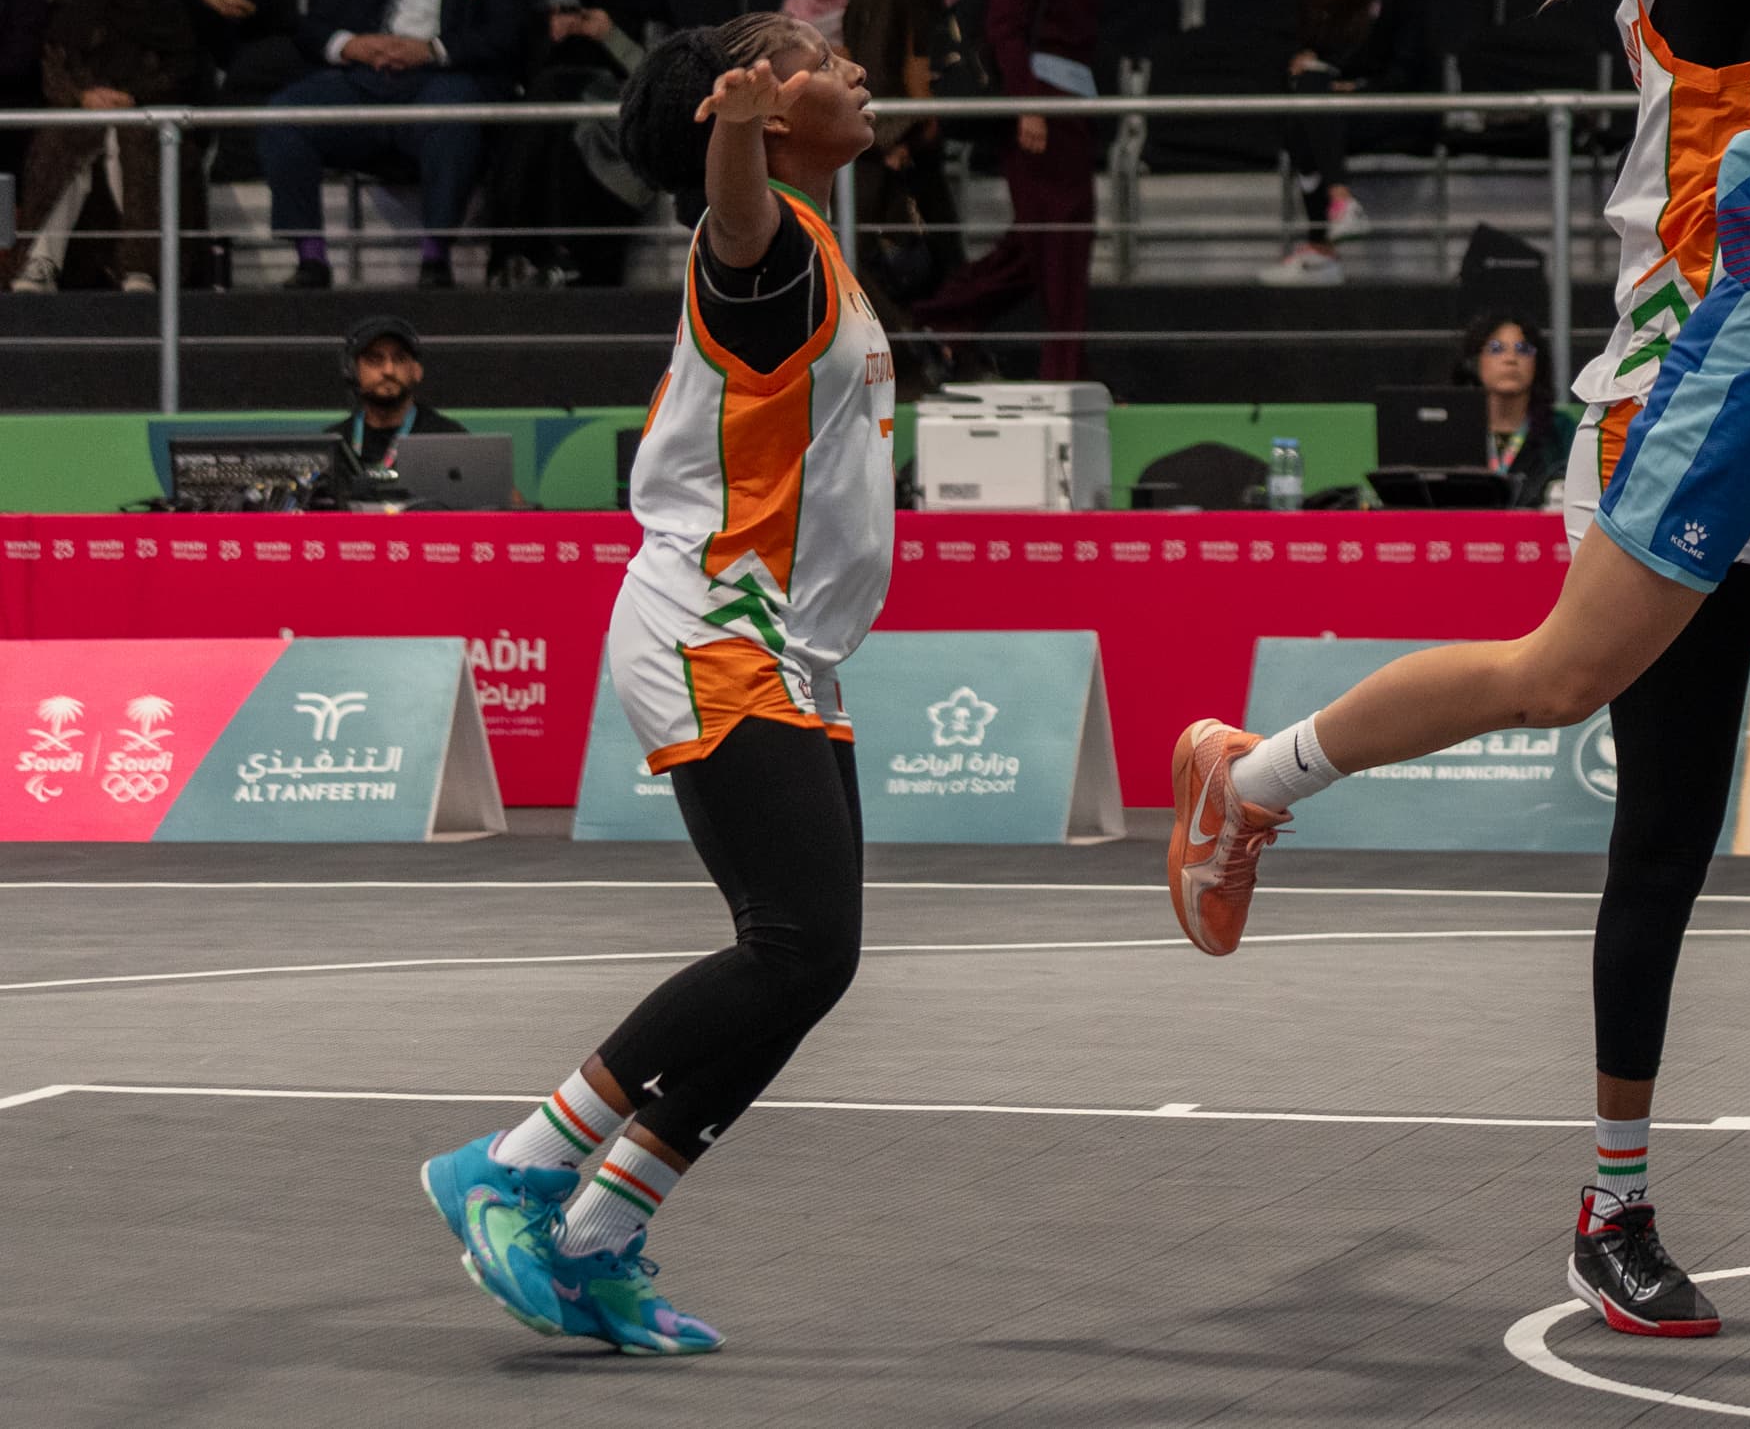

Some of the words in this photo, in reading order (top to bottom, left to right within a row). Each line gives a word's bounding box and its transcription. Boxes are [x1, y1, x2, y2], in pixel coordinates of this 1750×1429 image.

[1670, 535, 1705, 560] KELME
[16, 751, 84, 771] Saudi
[105, 751, 174, 771] Saudi
[237, 746, 403, 784] التنفيذي
[889, 753, 964, 777] الرياضة
[967, 753, 1020, 776] وزارة
[1436, 765, 1555, 780] MUNICIPALITY
[887, 778, 947, 795] Ministry
[950, 778, 967, 793] of
[969, 777, 1016, 795] Sport
